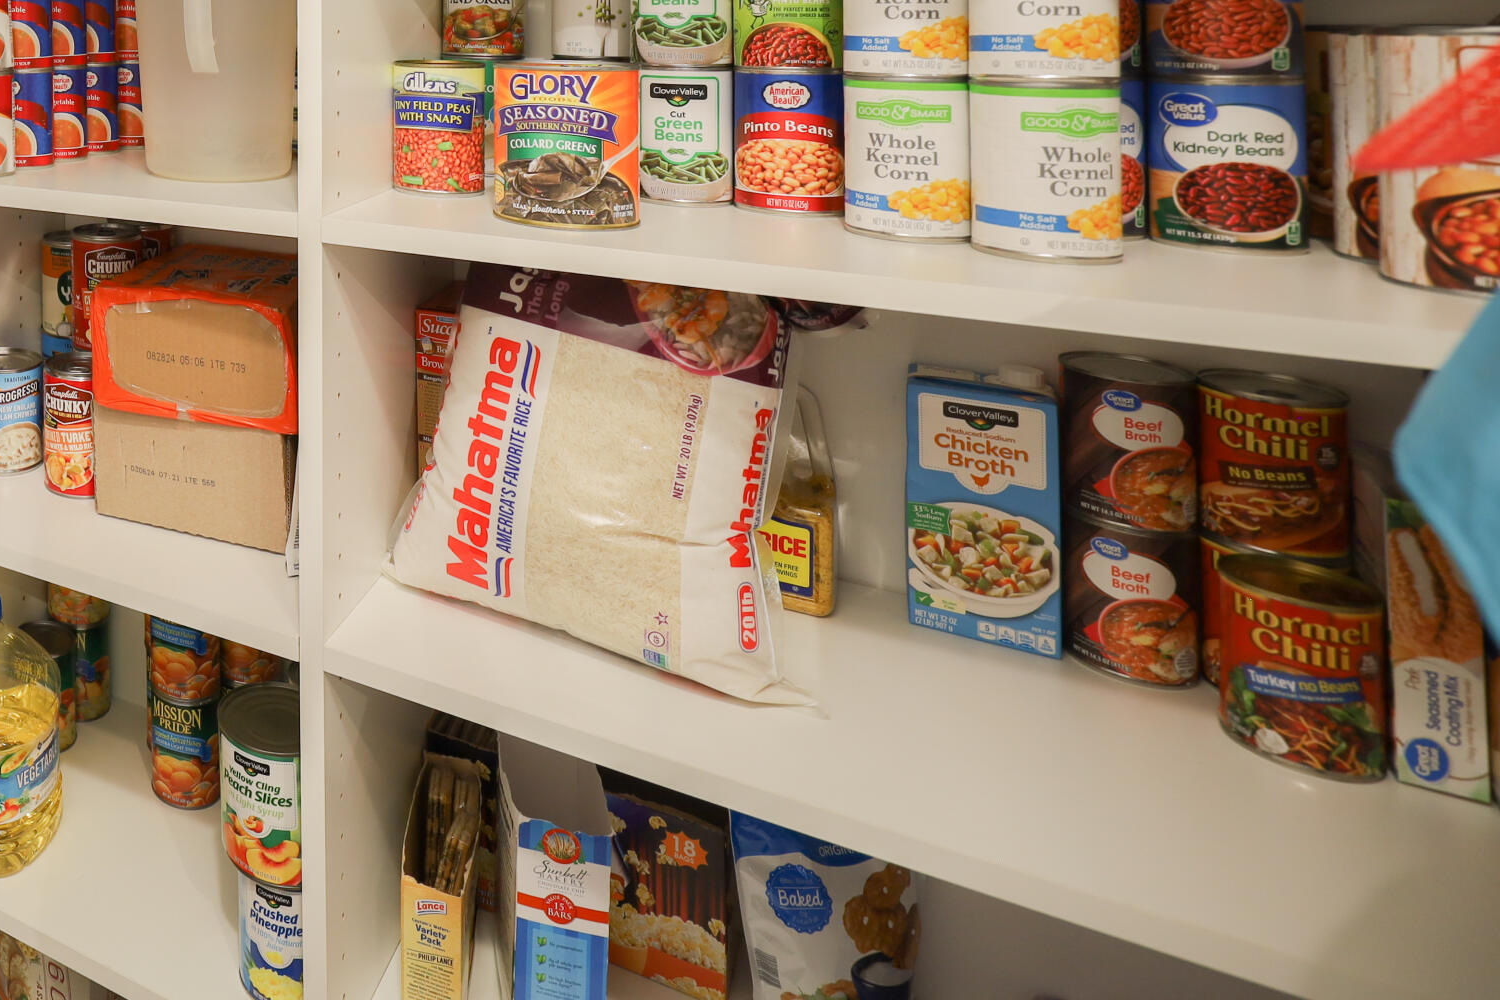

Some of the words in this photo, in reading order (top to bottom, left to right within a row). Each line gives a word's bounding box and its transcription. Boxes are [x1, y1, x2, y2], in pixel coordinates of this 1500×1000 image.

[884, 6, 940, 21] Corn
[1016, 1, 1081, 17] Corn
[874, 37, 890, 45] Salt
[510, 73, 598, 104] GLORY
[770, 87, 804, 95] American
[413, 100, 443, 113] FIELD
[446, 104, 471, 114] PEAS
[773, 96, 800, 105] Beauty
[1164, 100, 1206, 114] Great
[399, 112, 424, 122] WITH
[427, 114, 462, 126] SNAPS
[504, 107, 608, 132] SEASONED
[654, 116, 703, 130] Green
[1171, 110, 1207, 121] Value
[516, 121, 560, 132] SOUTHERN
[561, 122, 588, 135] STYLE
[655, 130, 703, 143] Beans
[744, 122, 780, 134] Pinto
[785, 120, 833, 137] Beans
[868, 131, 936, 150] Whole
[1207, 131, 1248, 144] Dark
[1254, 131, 1284, 144] Red
[510, 139, 552, 150] COLLARD
[556, 140, 596, 154] GREENS
[1041, 145, 1112, 164] Whole
[1173, 141, 1232, 157] Kidney
[1235, 144, 1285, 157] Beans
[866, 147, 939, 166] Kernel
[874, 164, 930, 182] Corn
[1038, 163, 1114, 181] Kernel
[1050, 180, 1107, 197] Corn
[97, 252, 126, 260] Campbell's
[88, 260, 135, 274] CHUNKY
[545, 280, 570, 321] Long
[14, 402, 36, 411] ENGLAND
[45, 393, 90, 415] CHUNKY
[1107, 393, 1134, 404] Great
[516, 396, 533, 427] RICE
[683, 394, 703, 433] (9.07kg)
[1204, 393, 1329, 439] Hormel
[1124, 417, 1163, 432] Beef
[681, 434, 693, 446] LB
[946, 427, 982, 438] Reduced
[984, 433, 1016, 443] Sodium
[1125, 430, 1162, 444] Broth
[1218, 424, 1310, 463] Chili
[679, 446, 692, 460] 20
[934, 433, 1029, 462] Chicken
[446, 335, 522, 591] Mahatma
[507, 426, 527, 487] FAVORITE
[948, 451, 1015, 477] Broth
[674, 463, 689, 480] WT.
[1228, 465, 1252, 482] No
[1255, 469, 1307, 484] Beans
[672, 479, 684, 500] NET
[495, 486, 517, 555] AMERICA'S
[916, 512, 942, 522] Sodium
[930, 508, 945, 516] Less
[1110, 565, 1151, 584] Beef
[1111, 578, 1150, 595] Broth
[1234, 592, 1371, 647] Hormel
[1251, 627, 1352, 671] Chili
[1246, 669, 1296, 692] Turkey
[1299, 675, 1315, 692] no
[1317, 678, 1360, 695] Beans
[1443, 675, 1459, 697] Mix
[1424, 670, 1441, 731] Seasoned
[154, 696, 202, 729] MISSION
[160, 717, 192, 735] PRIDE
[1446, 699, 1463, 746] Coating
[224, 768, 252, 798] Peach
[255, 791, 293, 807] Slices
[229, 765, 254, 785] Yellow
[256, 781, 280, 795] Cling
[672, 834, 697, 858] 18
[674, 851, 695, 865] BAGS
[533, 860, 587, 880] Sunbelt
[540, 872, 583, 887] BAKERY
[417, 902, 444, 911] Lance
[546, 895, 560, 904] VALUE
[562, 897, 573, 910] PACK
[554, 902, 564, 911] 15
[777, 890, 823, 907] Baked
[253, 900, 298, 924] Crushed
[548, 908, 572, 920] BARS
[250, 909, 303, 939] Pineapple
[415, 924, 446, 940] Variety
[421, 934, 441, 946] Pack
[418, 953, 436, 961] PHILIP
[436, 957, 453, 966] LANCE
